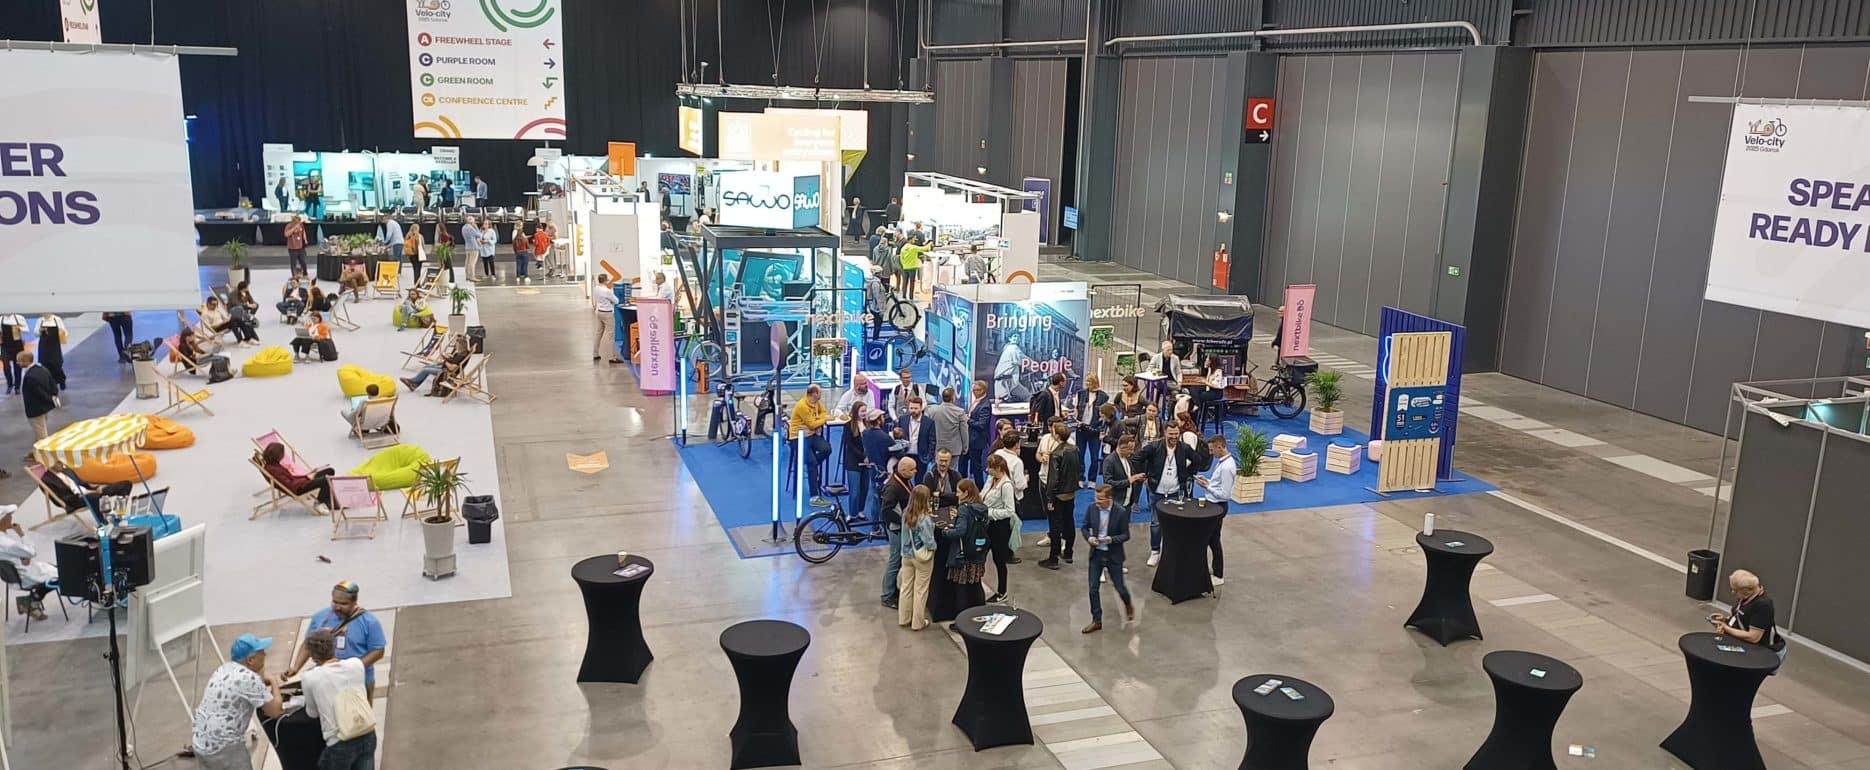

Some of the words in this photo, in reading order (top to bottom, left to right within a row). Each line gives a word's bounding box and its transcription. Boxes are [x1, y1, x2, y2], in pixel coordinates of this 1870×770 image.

[416, 10, 450, 19] Velo-city
[420, 34, 430, 45] A
[435, 36, 484, 46] FREEWHEEL
[485, 38, 512, 46] STAGE
[421, 54, 432, 65] C
[436, 56, 468, 65] PURPLE
[469, 58, 496, 66] ROOM
[422, 74, 433, 85] C
[437, 76, 466, 85] GREEN
[467, 77, 494, 85] ROOM
[438, 96, 495, 105] CONFERENCE
[496, 97, 528, 106] CENTRE
[1253, 103, 1268, 124] C
[1745, 135, 1785, 148] Velo-city
[0, 142, 67, 177] ER
[0, 190, 101, 225] ONS
[722, 190, 791, 210] SAWO
[1749, 212, 1862, 250] READY
[986, 313, 1052, 331] Bringing
[1293, 312, 1304, 351] nextbike
[1021, 356, 1073, 374] People
